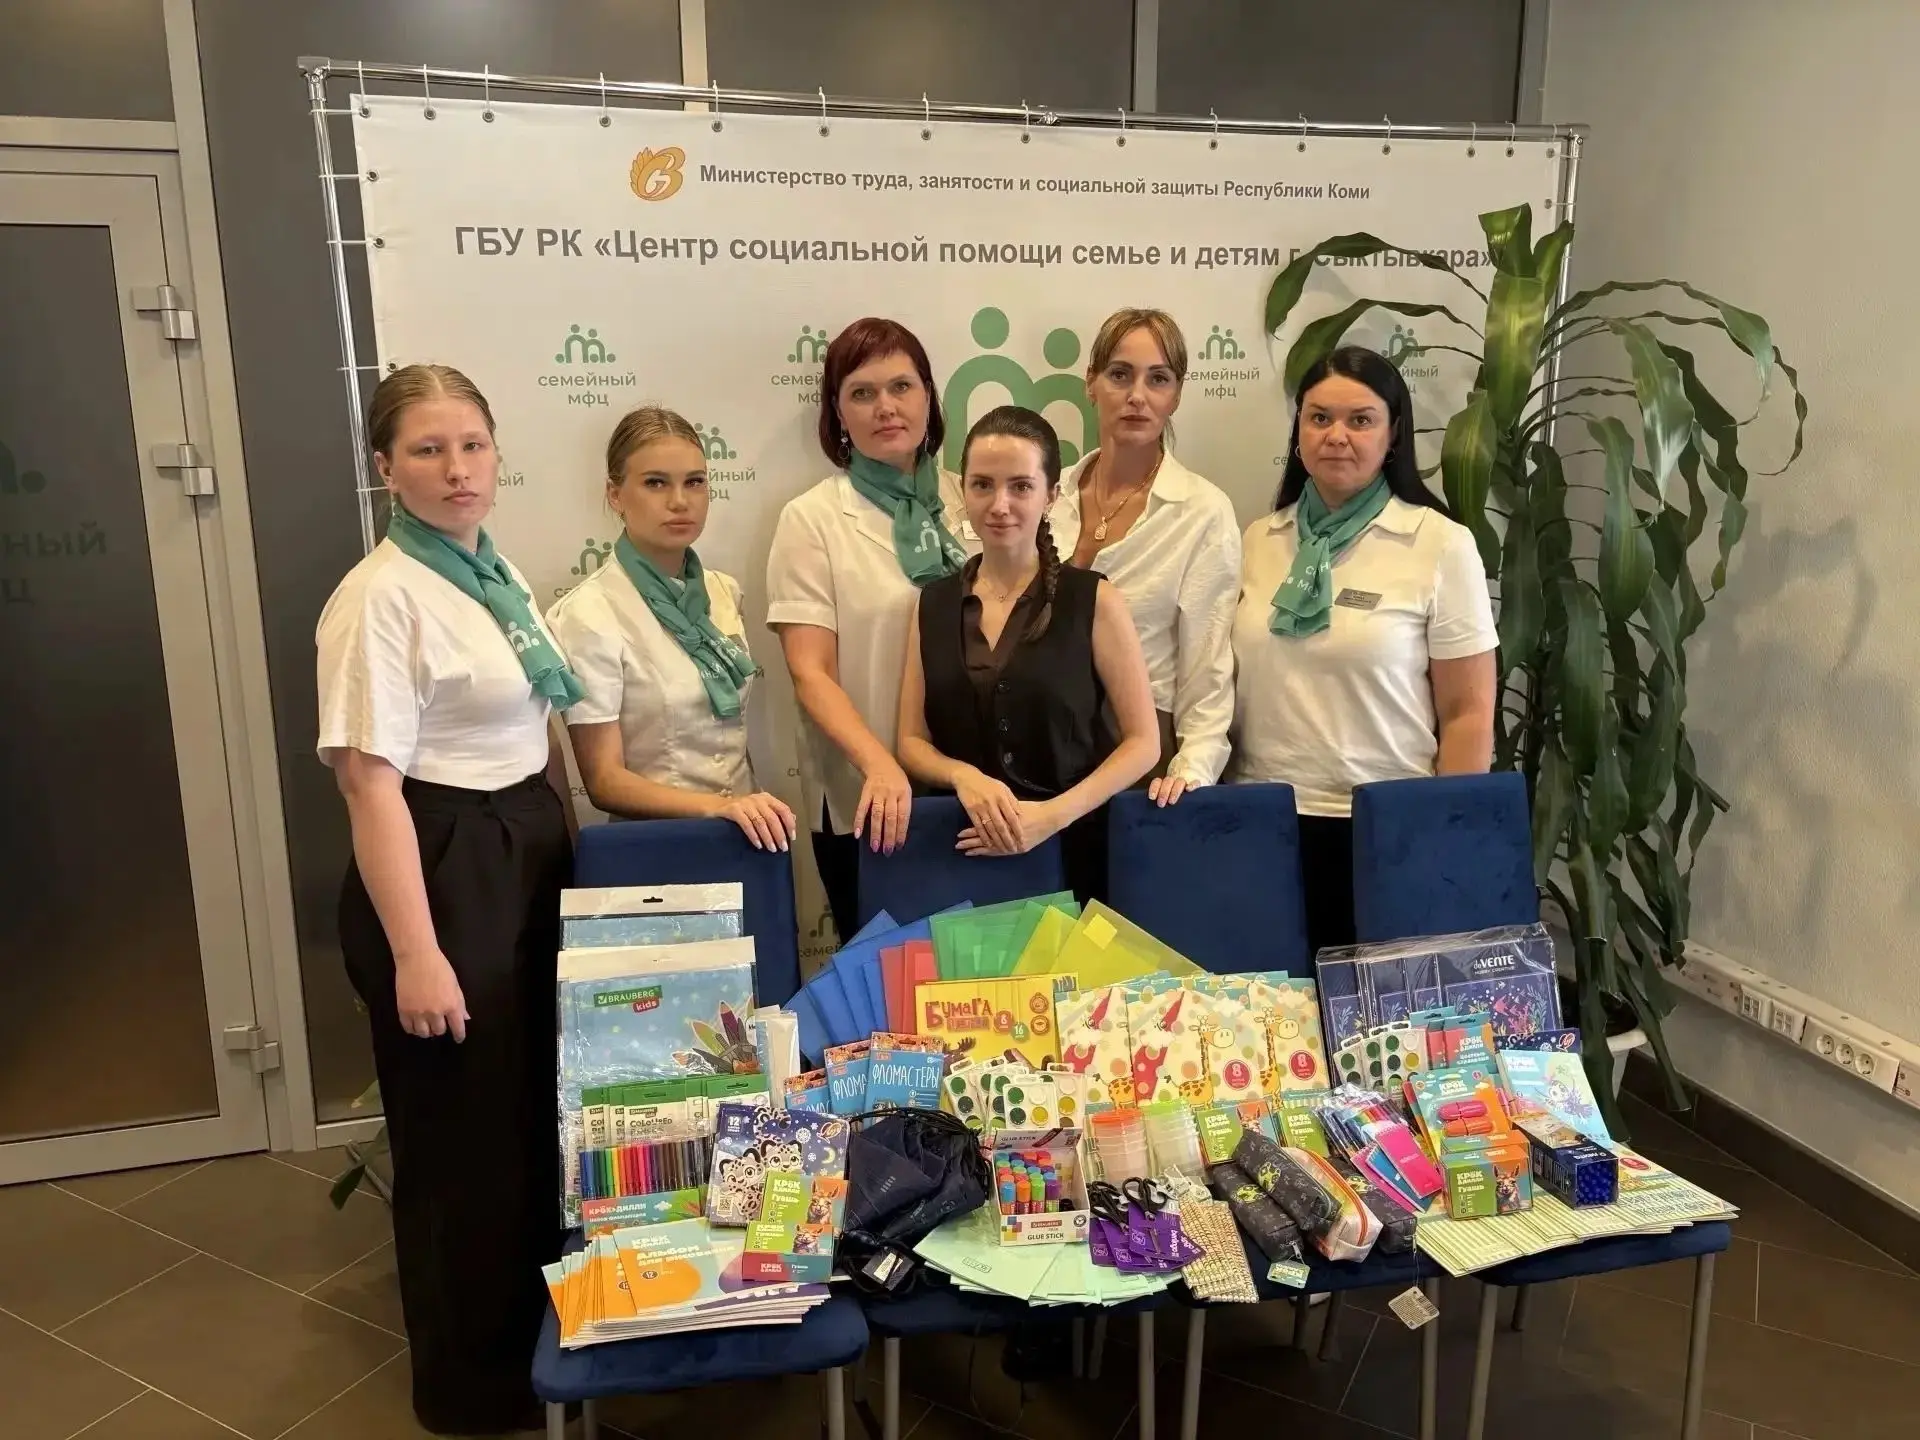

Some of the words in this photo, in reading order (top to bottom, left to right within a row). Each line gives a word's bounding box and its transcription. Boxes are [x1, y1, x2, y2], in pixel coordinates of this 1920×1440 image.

[700, 165, 847, 188] Министерство
[852, 172, 913, 191] труда,
[919, 173, 1013, 191] занятости
[1020, 178, 1030, 190] и
[1036, 178, 1146, 195] социальной
[1151, 182, 1219, 197] защиты
[1224, 181, 1323, 200] Республики
[1328, 183, 1370, 199] Коми
[455, 226, 524, 256] ГБУ
[537, 228, 583, 257] РК
[594, 230, 719, 265] «Центр
[730, 236, 928, 265] социальной
[939, 242, 1062, 268] помощи
[1072, 245, 1161, 265] семье
[1171, 247, 1187, 265] и
[1195, 247, 1279, 270] детям
[538, 371, 636, 387] семейный
[771, 371, 825, 386] семей
[798, 389, 822, 407] мф
[1204, 384, 1237, 399] мфц
[568, 392, 609, 407] мфц
[708, 467, 756, 482] йный
[608, 990, 654, 1003] BRAUBERG
[636, 1000, 657, 1011] kids
[1014, 1024, 1024, 1035] 16
[872, 1064, 940, 1089] ФЛОМАСТЕРЫ
[1231, 1063, 1242, 1077] 8
[729, 1116, 740, 1126] 12
[1046, 1232, 1064, 1240] STICK
[646, 1271, 655, 1279] 12
